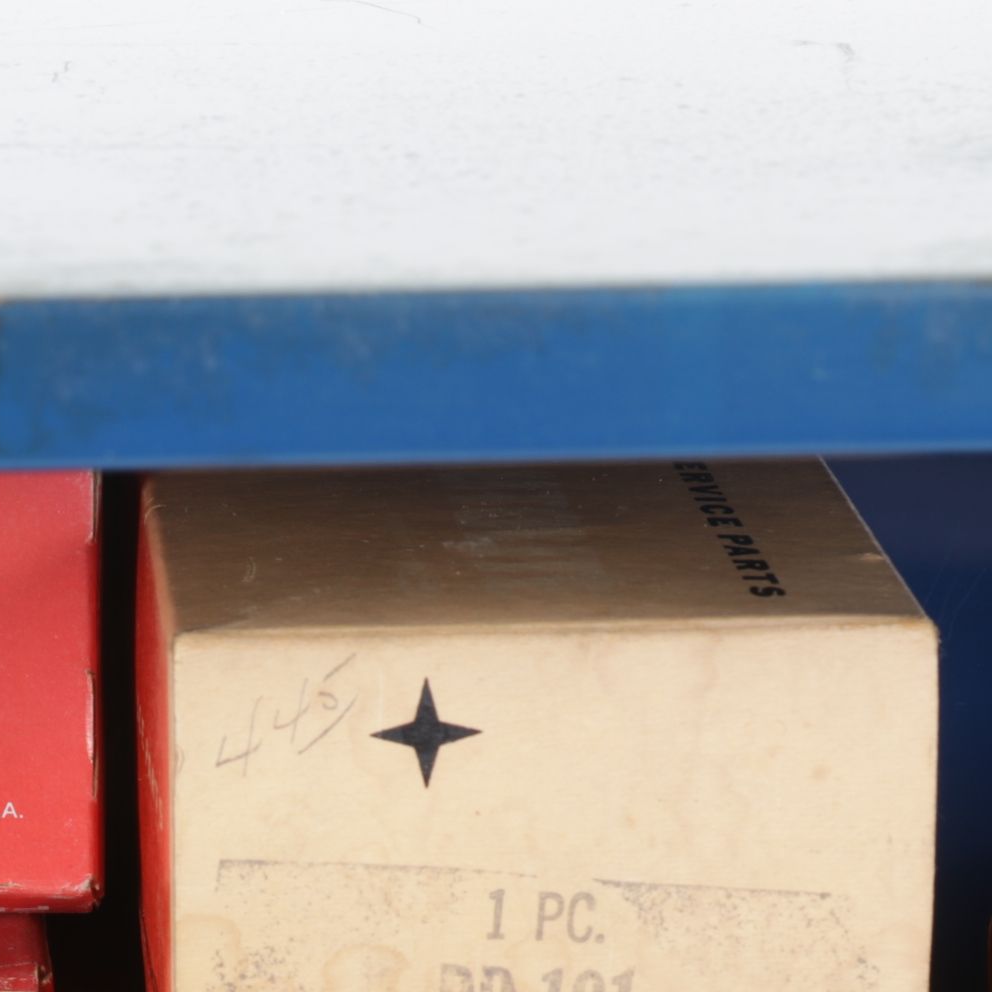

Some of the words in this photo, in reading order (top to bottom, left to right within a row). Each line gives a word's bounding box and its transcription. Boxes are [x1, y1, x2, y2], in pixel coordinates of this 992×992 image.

[672, 462, 745, 528] ERVICE
[715, 533, 788, 599] PARTS
[485, 890, 507, 940] 1
[534, 892, 606, 943] PC.
